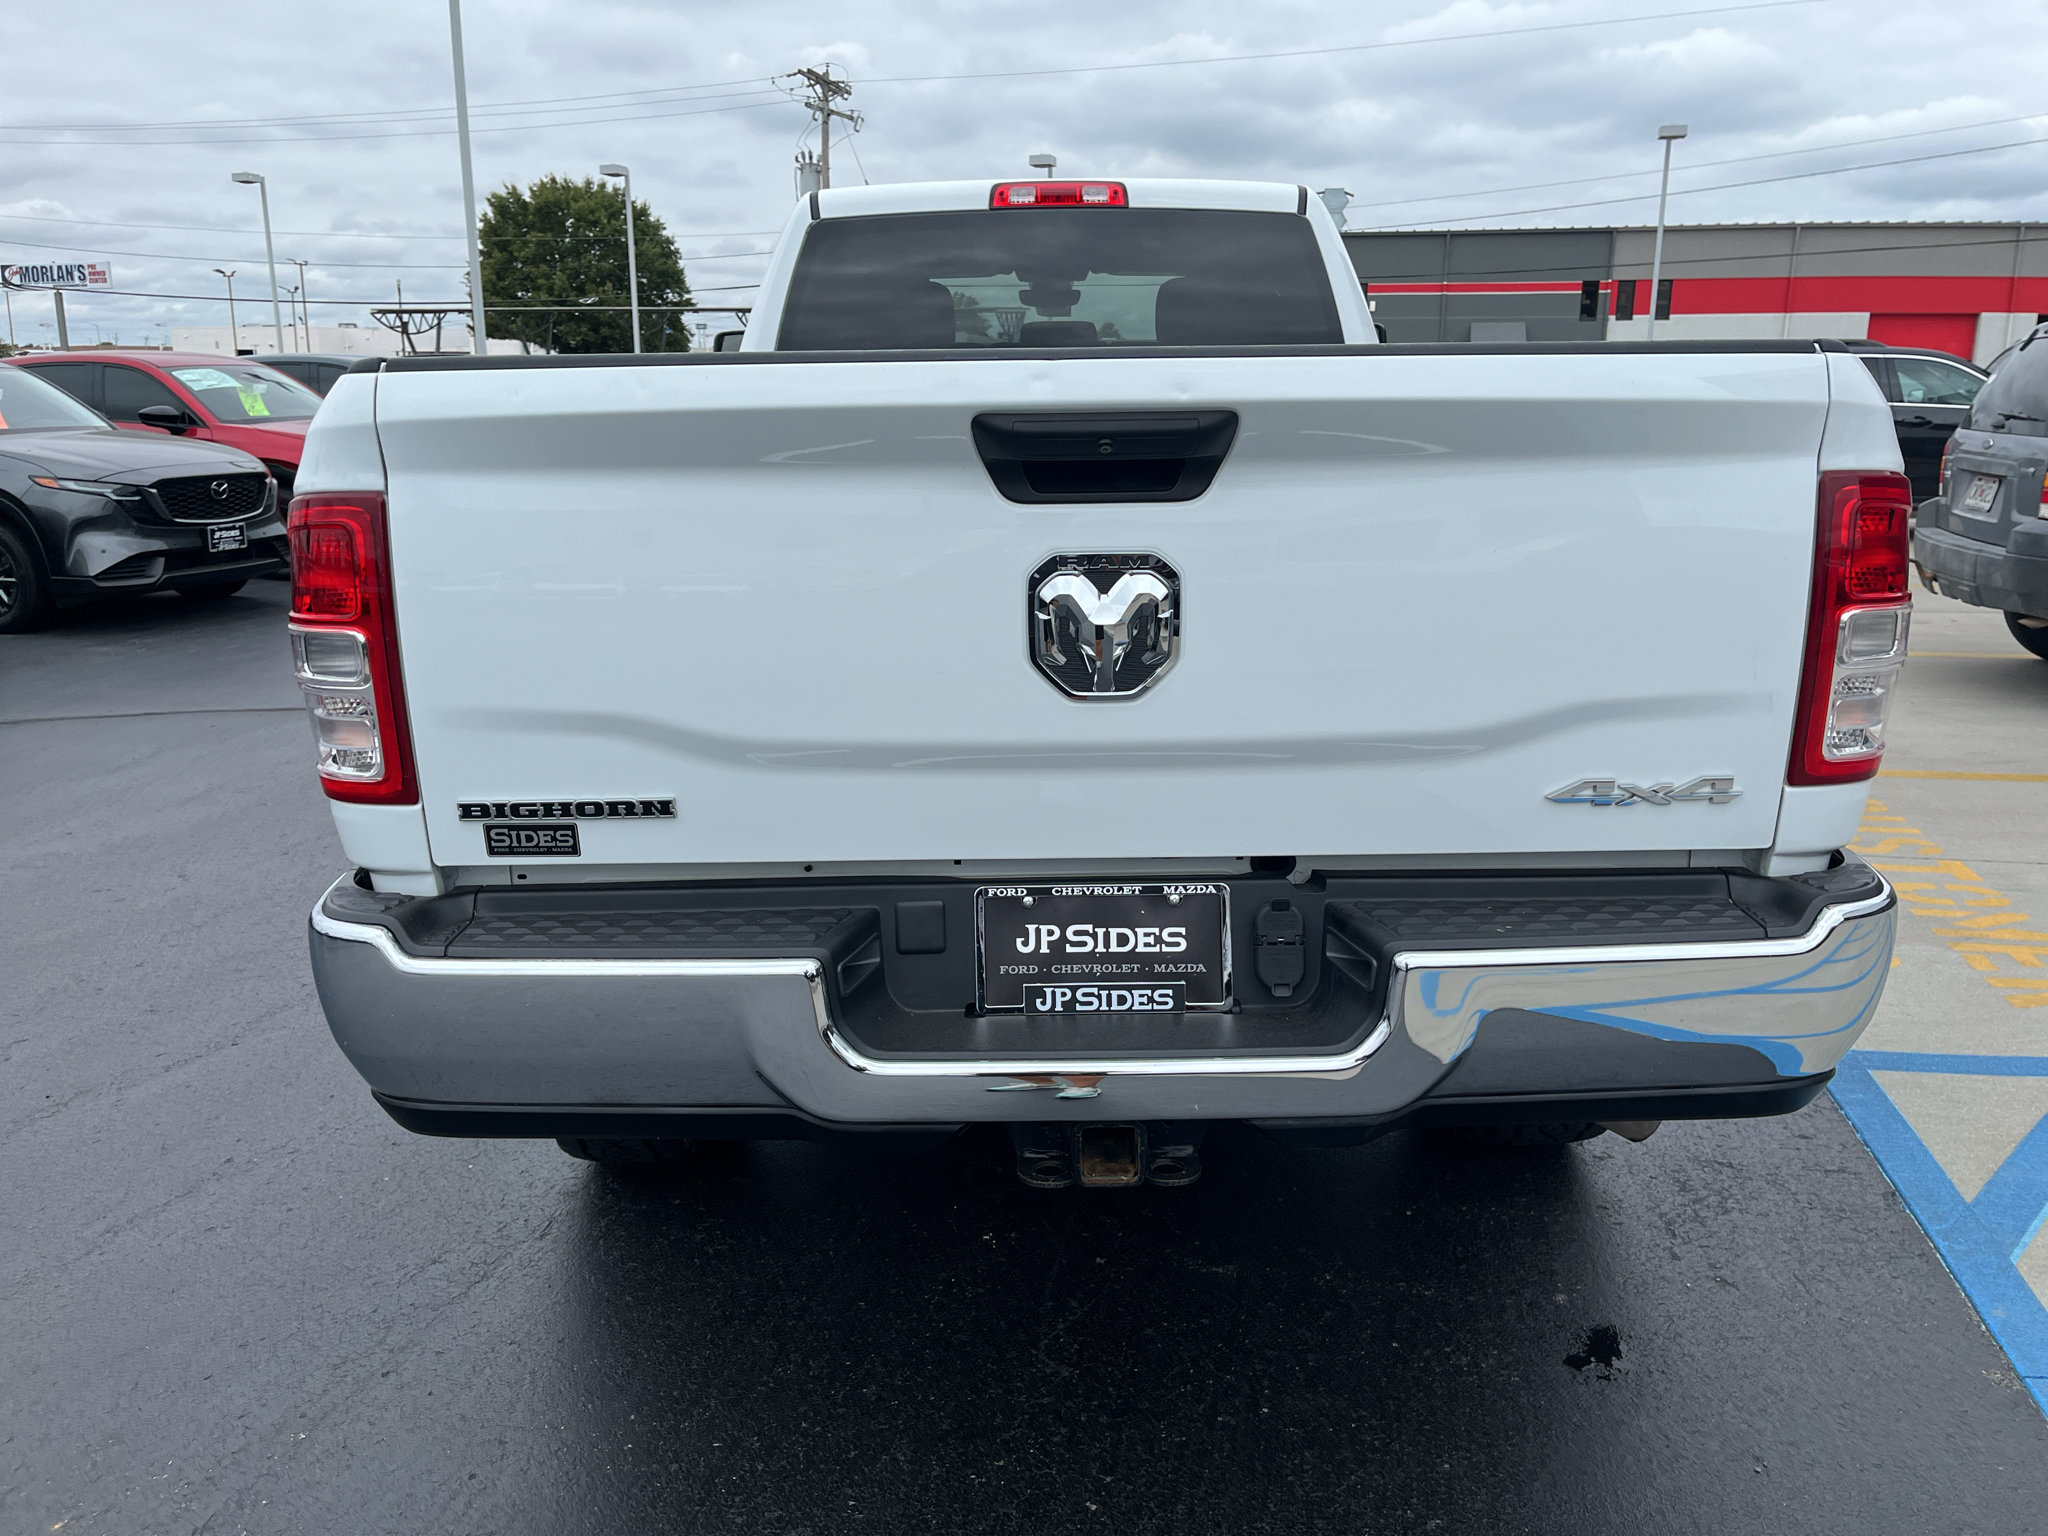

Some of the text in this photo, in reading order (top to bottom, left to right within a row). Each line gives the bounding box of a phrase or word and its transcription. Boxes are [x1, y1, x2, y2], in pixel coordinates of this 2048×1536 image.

[20, 264, 86, 283] MORLAN'S
[1057, 555, 1150, 570] RAM
[456, 798, 677, 821] BIGHORN
[489, 828, 574, 847] SIDES
[987, 885, 1217, 897] FORD CHEVROLET MAZDA
[1015, 924, 1188, 954] JP SIDES
[999, 963, 1207, 975] FORD CHEVROLET MAZDA
[1035, 987, 1073, 1012] JP
